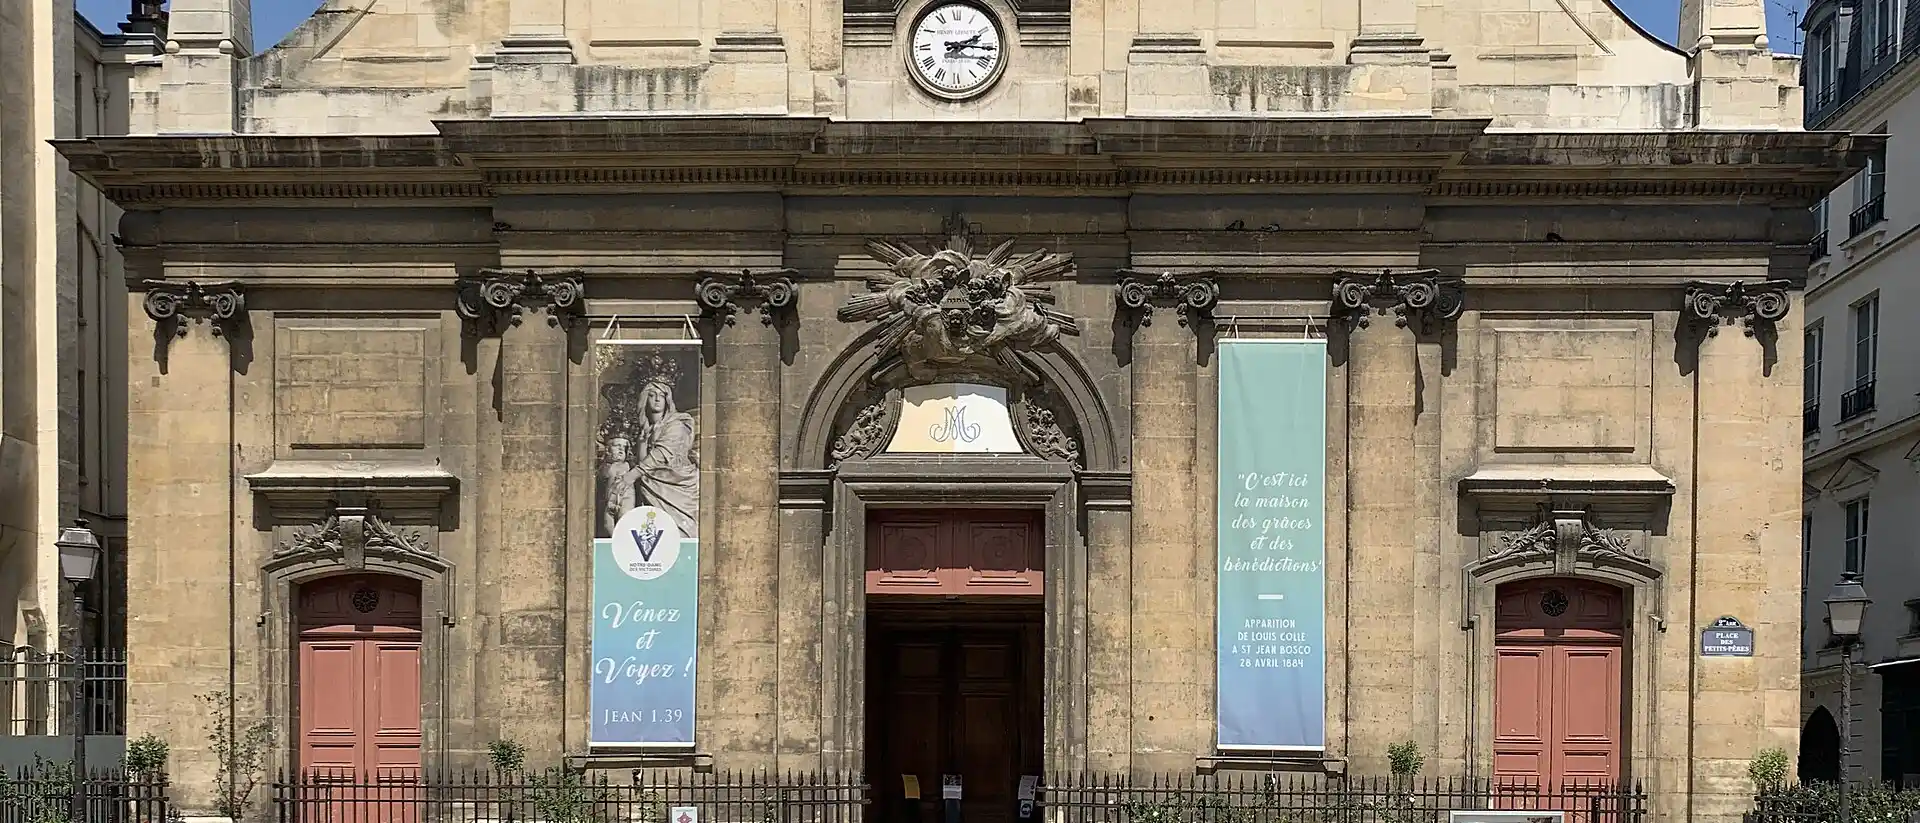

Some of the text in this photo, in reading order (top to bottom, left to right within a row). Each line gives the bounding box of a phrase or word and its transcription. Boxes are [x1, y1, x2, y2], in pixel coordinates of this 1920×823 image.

[1288, 473, 1308, 487] ici
[1234, 492, 1310, 508] la maison
[1231, 513, 1313, 534] des grâces
[1250, 534, 1294, 550] et des
[602, 600, 681, 629] Venez
[1244, 618, 1296, 629] APPARITION
[635, 629, 662, 650] et
[1237, 631, 1306, 642] DE LOUIS COLLE
[1231, 644, 1312, 655] A ST JEAN BOSCO
[595, 655, 674, 686] Voyez
[1239, 658, 1304, 668] 28 AVRIL 1884
[603, 709, 683, 725] JEAN 1.39
